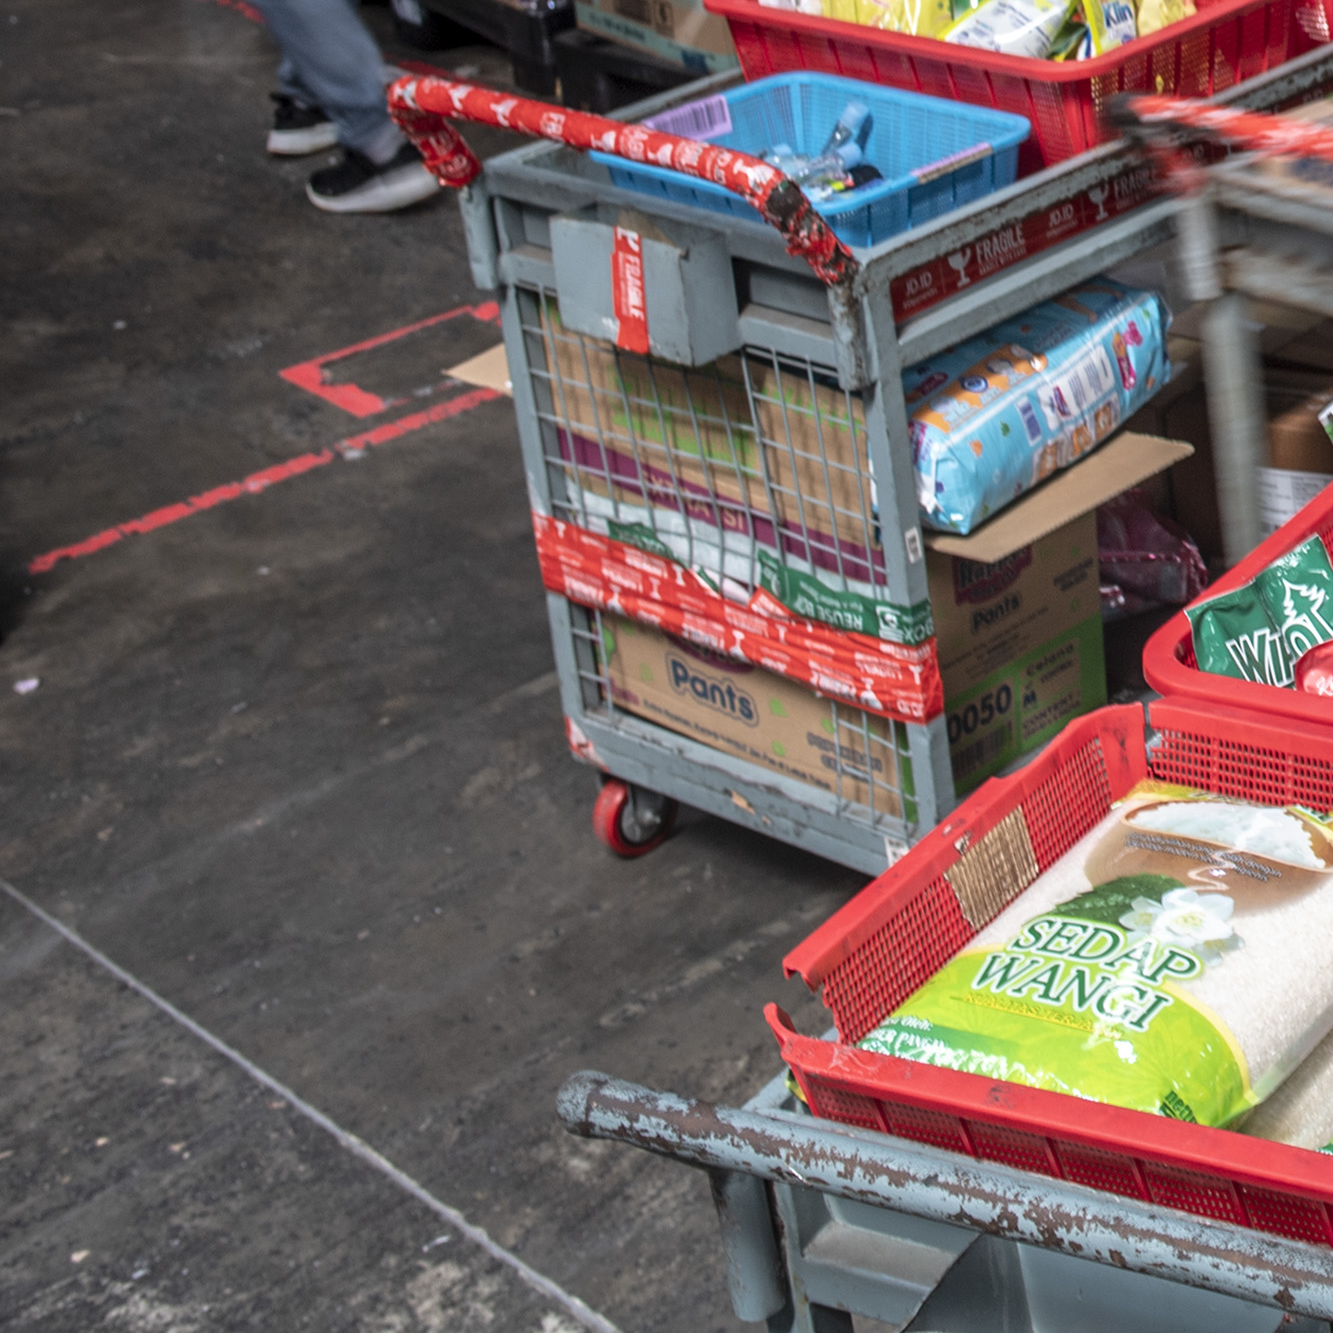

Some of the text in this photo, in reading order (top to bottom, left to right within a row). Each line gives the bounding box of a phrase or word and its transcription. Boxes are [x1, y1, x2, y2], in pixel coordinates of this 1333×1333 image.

[1103, 0, 1133, 28] Klin
[621, 249, 644, 320] FRAGILE
[903, 271, 935, 300] JD.ID
[975, 223, 1025, 266] FRAGILE
[1047, 202, 1076, 230] JD.ID
[820, 609, 864, 632] REUSE
[971, 595, 1021, 635] Pants
[670, 657, 755, 721] Pants
[1013, 918, 1199, 988] SEDAP
[973, 953, 1171, 1031] WANGI
